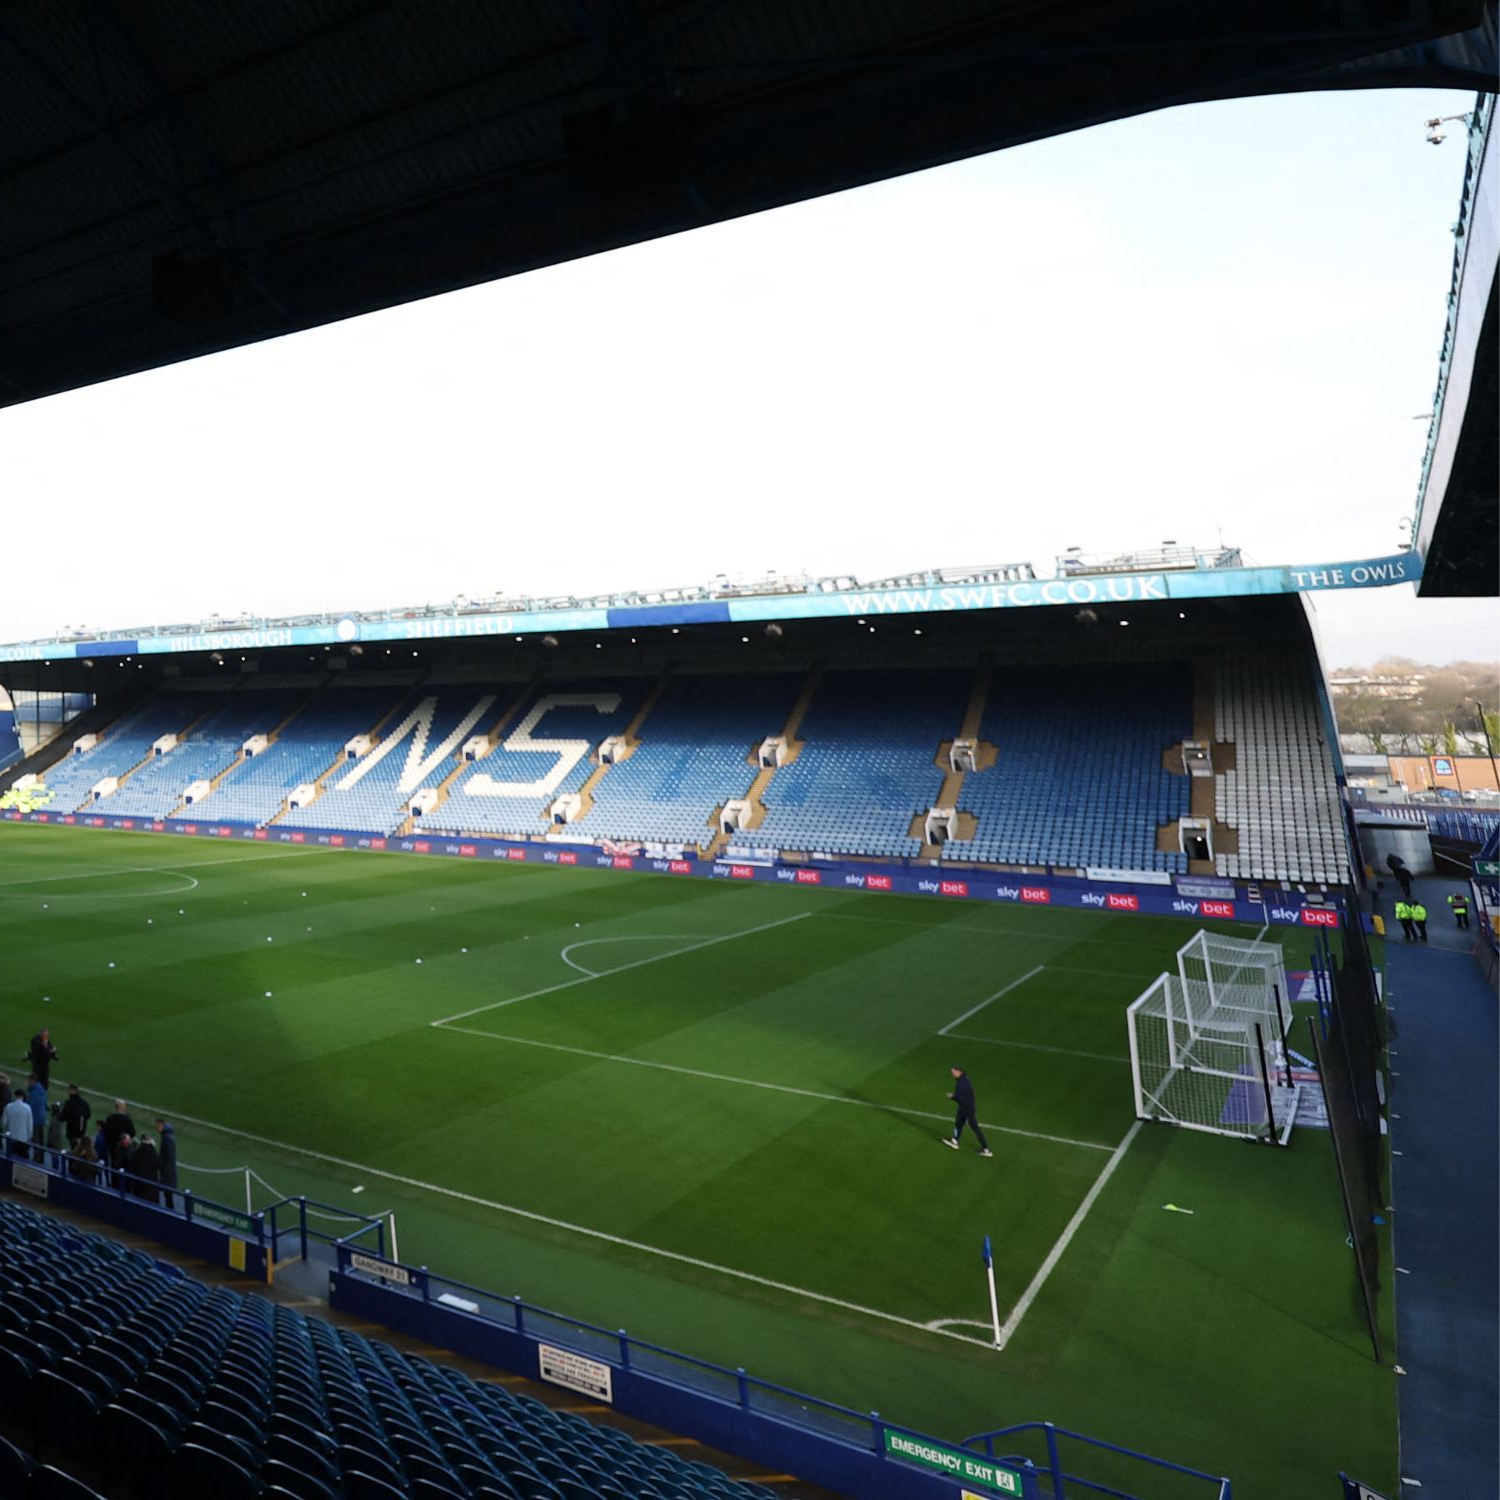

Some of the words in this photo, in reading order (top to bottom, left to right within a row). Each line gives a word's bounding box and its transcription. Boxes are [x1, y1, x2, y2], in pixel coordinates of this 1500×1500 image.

[1291, 569, 1344, 588] THE
[1350, 560, 1406, 586] OWLS
[842, 575, 1169, 616] WWW.SWFC.CO.UK
[406, 616, 514, 638] SHEFFIELD
[170, 630, 292, 652] HILLSBOROUGH
[449, 844, 460, 854] sky
[462, 847, 475, 855] bet
[495, 847, 508, 858] sky
[510, 850, 525, 859] bet
[546, 851, 559, 862] sky
[561, 854, 576, 863] bet
[598, 855, 612, 866] sky
[614, 858, 631, 867] bet
[653, 857, 669, 870] sky
[671, 861, 690, 872] bet
[715, 862, 731, 875] sky
[733, 866, 752, 877] bet
[779, 867, 795, 881] sky
[798, 871, 819, 883] bet
[846, 873, 864, 887] sky
[867, 877, 890, 889] bet
[920, 879, 939, 893] sky
[942, 883, 965, 895] bet
[999, 885, 1019, 900] sky
[1022, 889, 1047, 902] bet
[1082, 891, 1105, 906] sky
[1109, 895, 1136, 909] bet
[1173, 899, 1198, 914] sky
[1202, 903, 1232, 917] bet
[1271, 907, 1298, 923] sky
[1303, 911, 1336, 926] bet
[890, 1436, 962, 1472] EMERGENCY
[965, 1461, 994, 1482] EXIT
